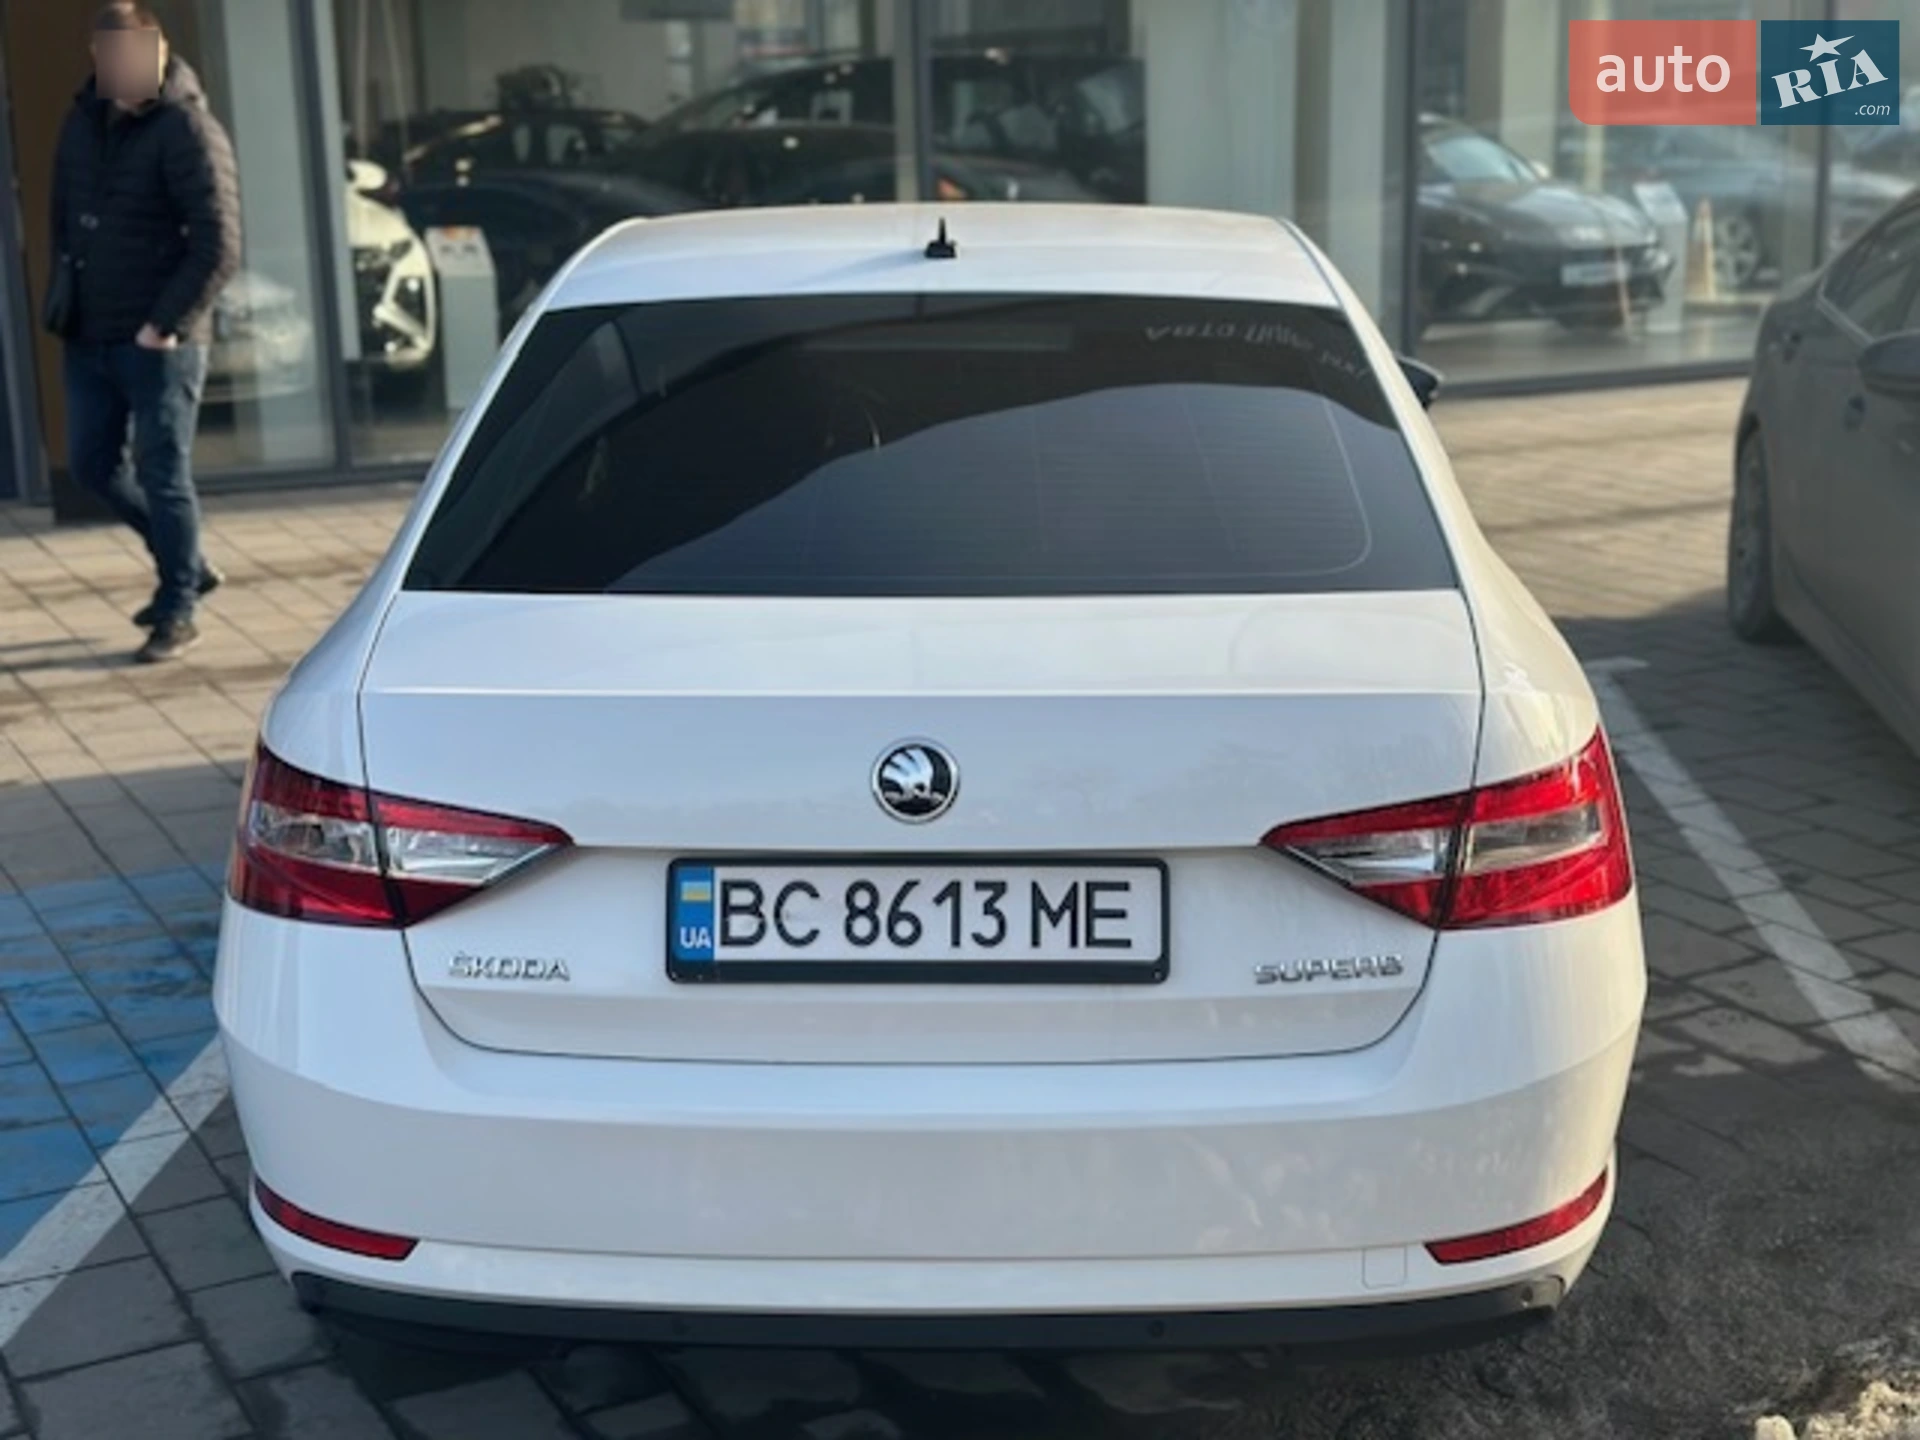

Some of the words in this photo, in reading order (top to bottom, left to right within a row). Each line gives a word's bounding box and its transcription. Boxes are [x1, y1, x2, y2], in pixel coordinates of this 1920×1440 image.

[720, 880, 820, 948] BC
[843, 879, 1010, 948] 8613
[1031, 880, 1133, 948] ME
[680, 926, 712, 949] UA
[1254, 954, 1404, 985] SUPERB
